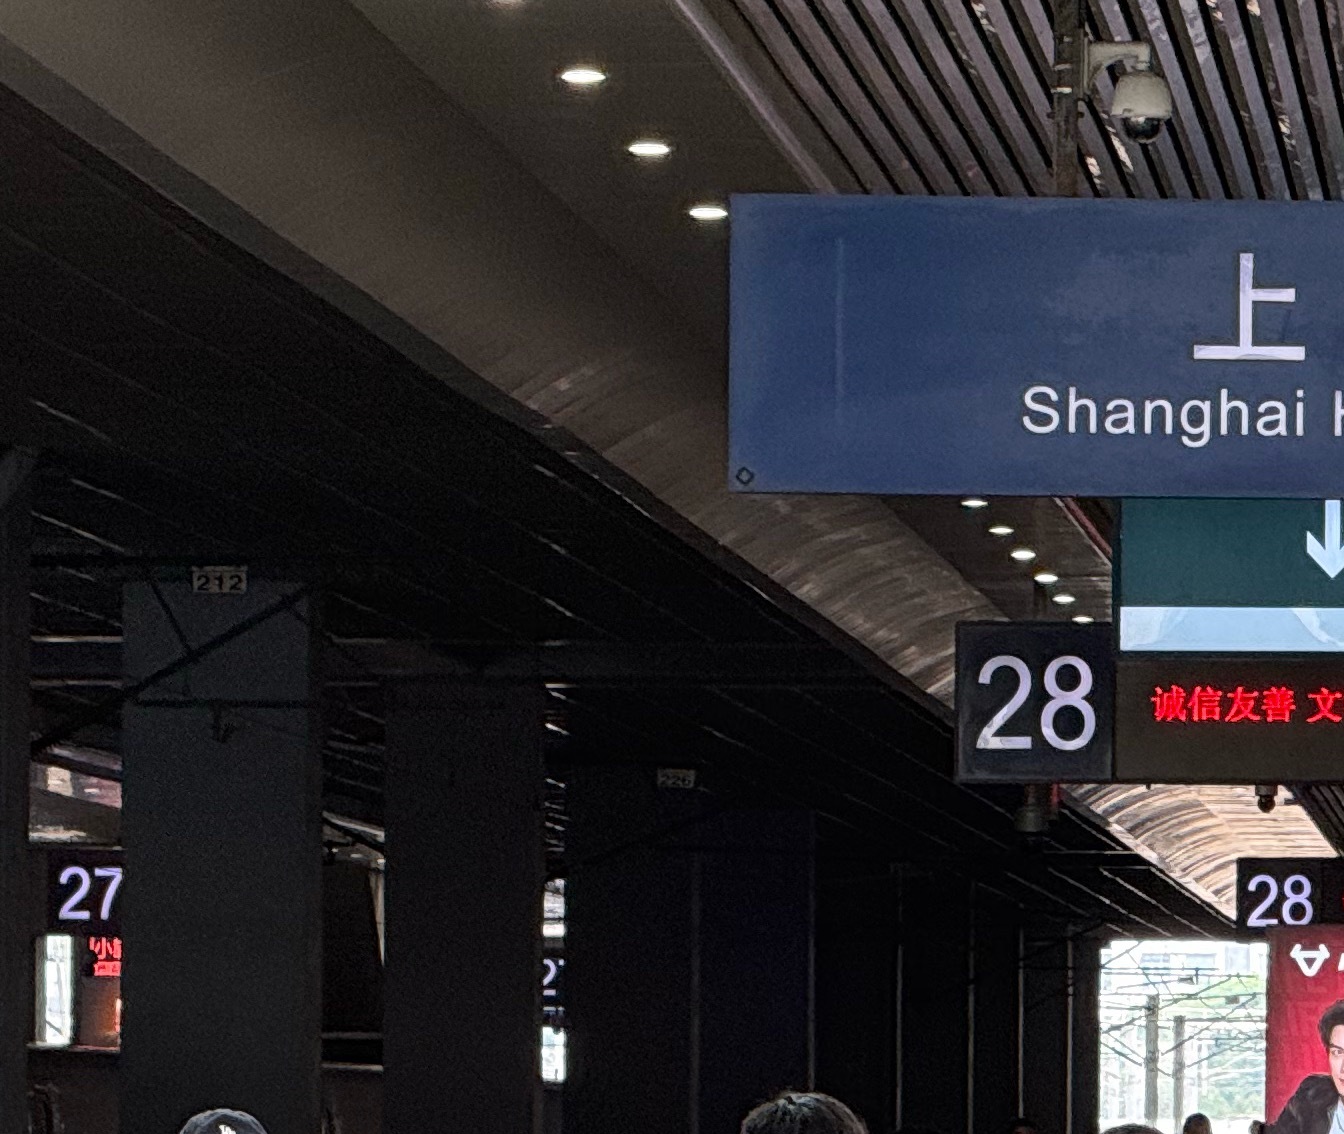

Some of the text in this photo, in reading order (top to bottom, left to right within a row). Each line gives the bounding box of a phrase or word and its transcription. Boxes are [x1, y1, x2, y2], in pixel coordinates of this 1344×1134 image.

[1022, 385, 1306, 449] Shanghai
[197, 574, 243, 591] 212
[976, 654, 1096, 750] 28
[1150, 686, 1297, 724] 诚信友善
[58, 866, 123, 921] 27
[1247, 874, 1313, 926] 28
